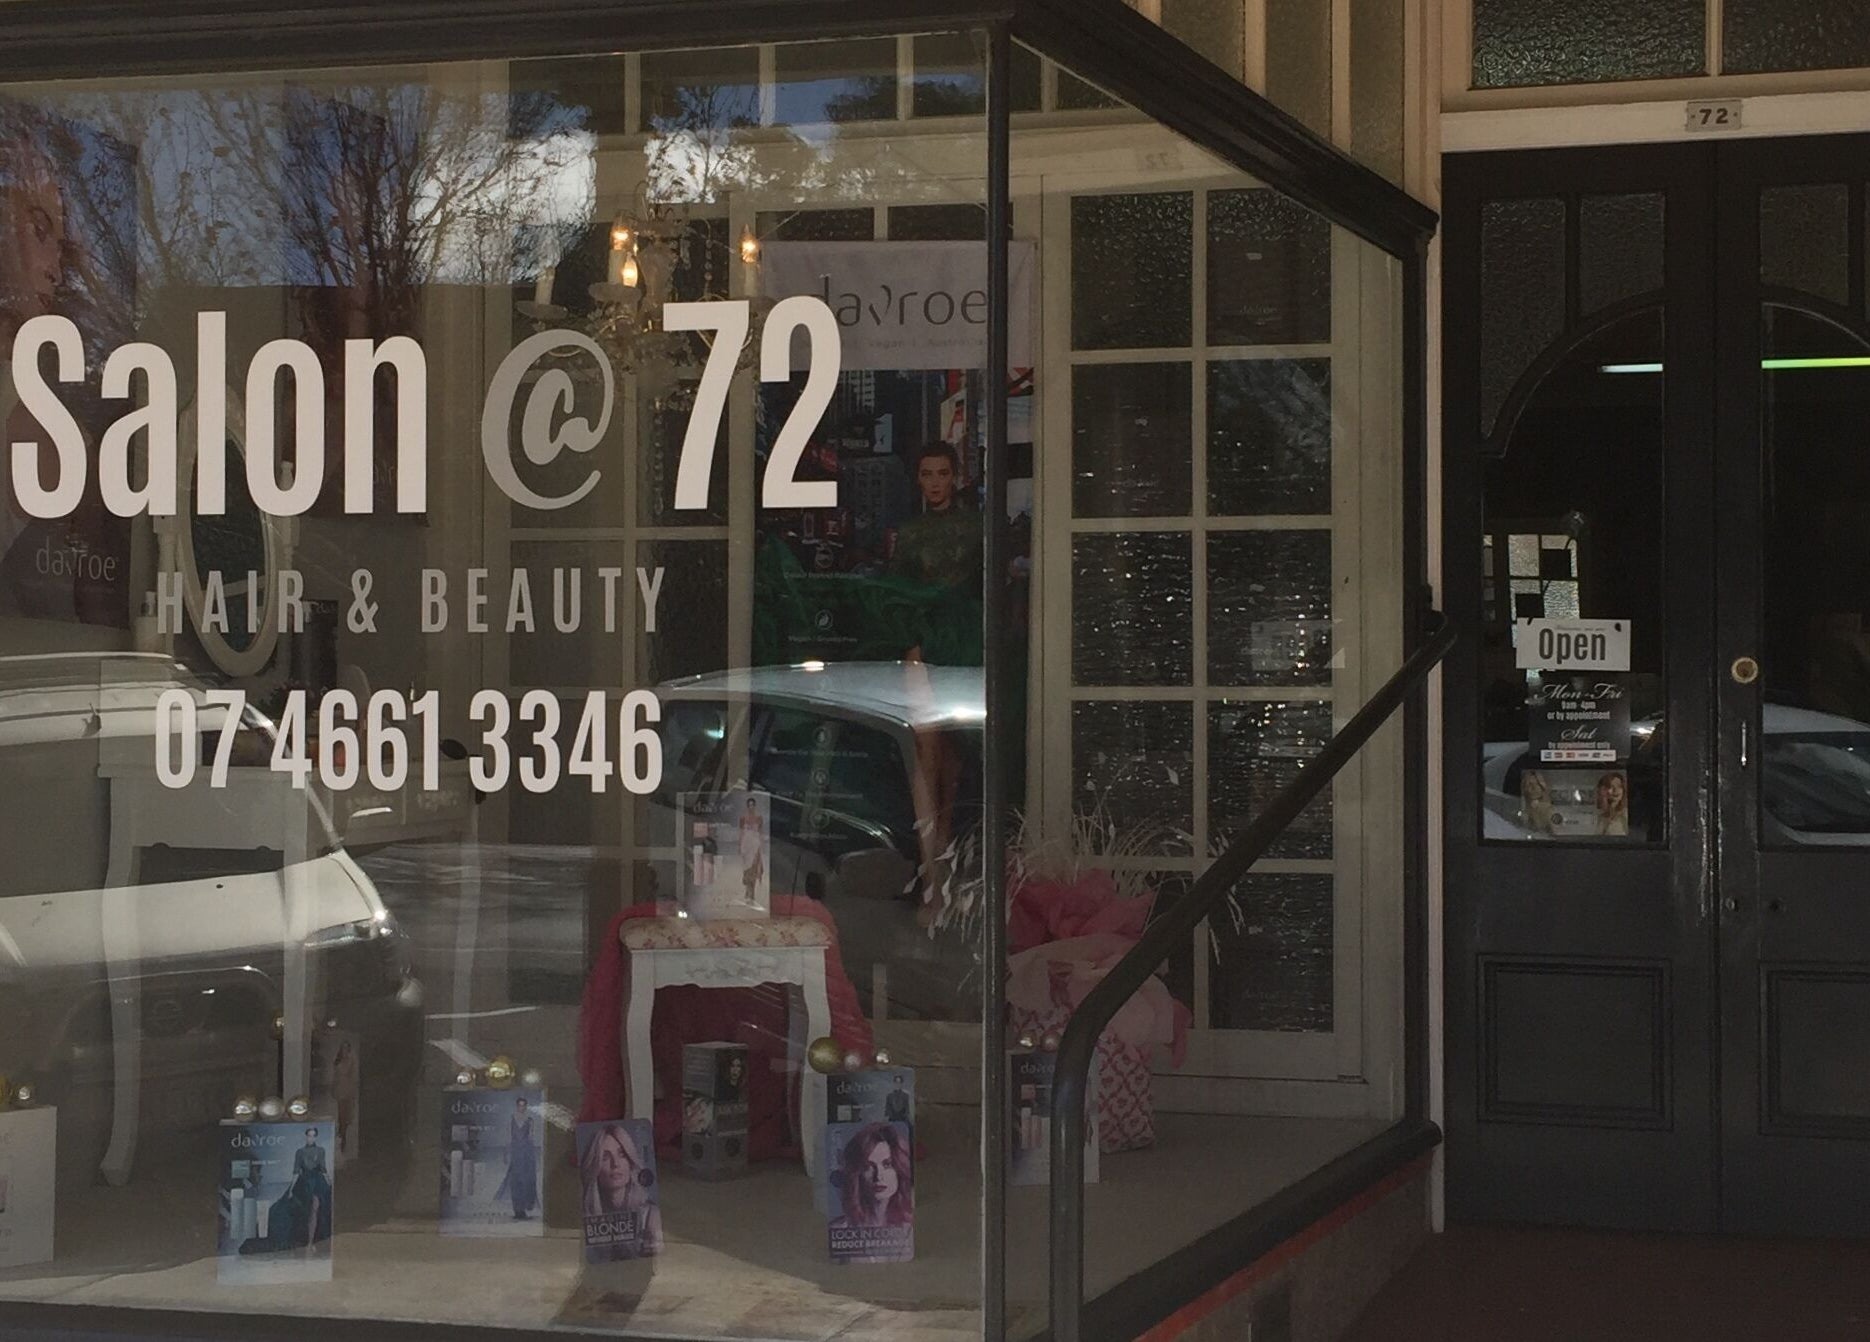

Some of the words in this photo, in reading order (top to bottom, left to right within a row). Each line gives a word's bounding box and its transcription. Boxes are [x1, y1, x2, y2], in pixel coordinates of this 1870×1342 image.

[1698, 107, 1729, 125] 72
[11, 309, 428, 519] Salon
[482, 329, 614, 508] @
[662, 296, 842, 511] 72
[157, 569, 305, 635] HAIR
[346, 568, 379, 634] &
[421, 566, 667, 634] BEAUTY
[1538, 627, 1606, 665] Open
[1546, 711, 1555, 720] or
[1555, 711, 1565, 721] by
[1565, 711, 1610, 721] appointment
[155, 689, 246, 789] 07
[270, 690, 438, 791] 4661
[470, 690, 663, 794] 3346
[1560, 724, 1598, 740] Sat
[586, 1219, 635, 1237] BLONDE
